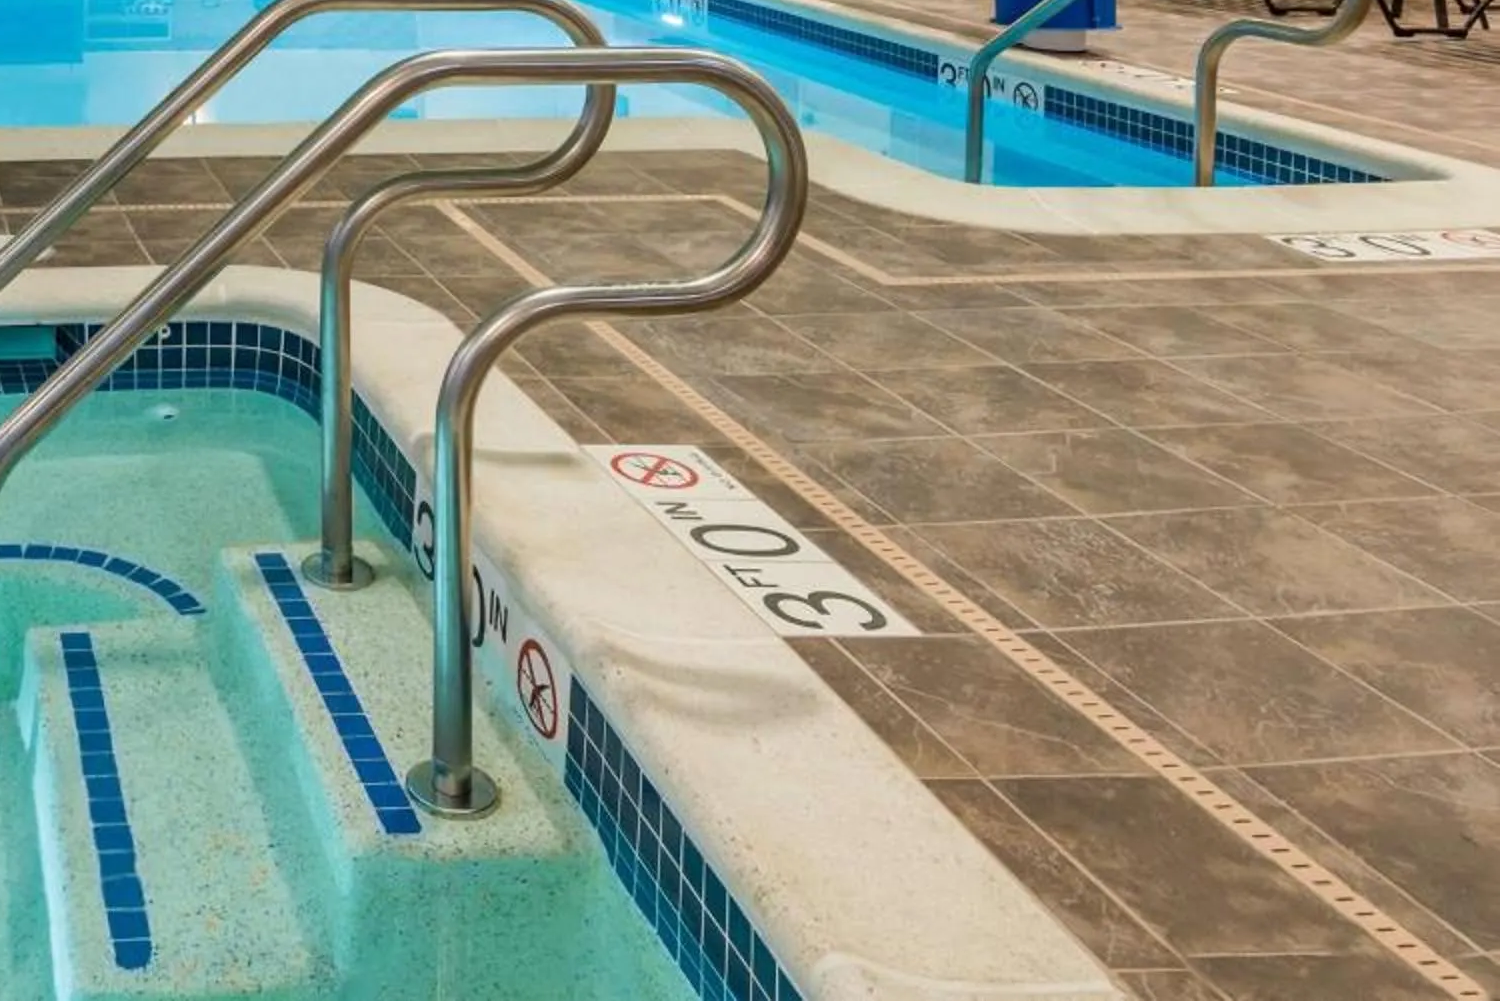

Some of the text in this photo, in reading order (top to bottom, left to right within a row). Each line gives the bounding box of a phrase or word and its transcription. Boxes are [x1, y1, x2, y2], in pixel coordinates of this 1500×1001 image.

[655, 500, 888, 632] 3 FT 0 IN
[488, 588, 509, 645] IN
